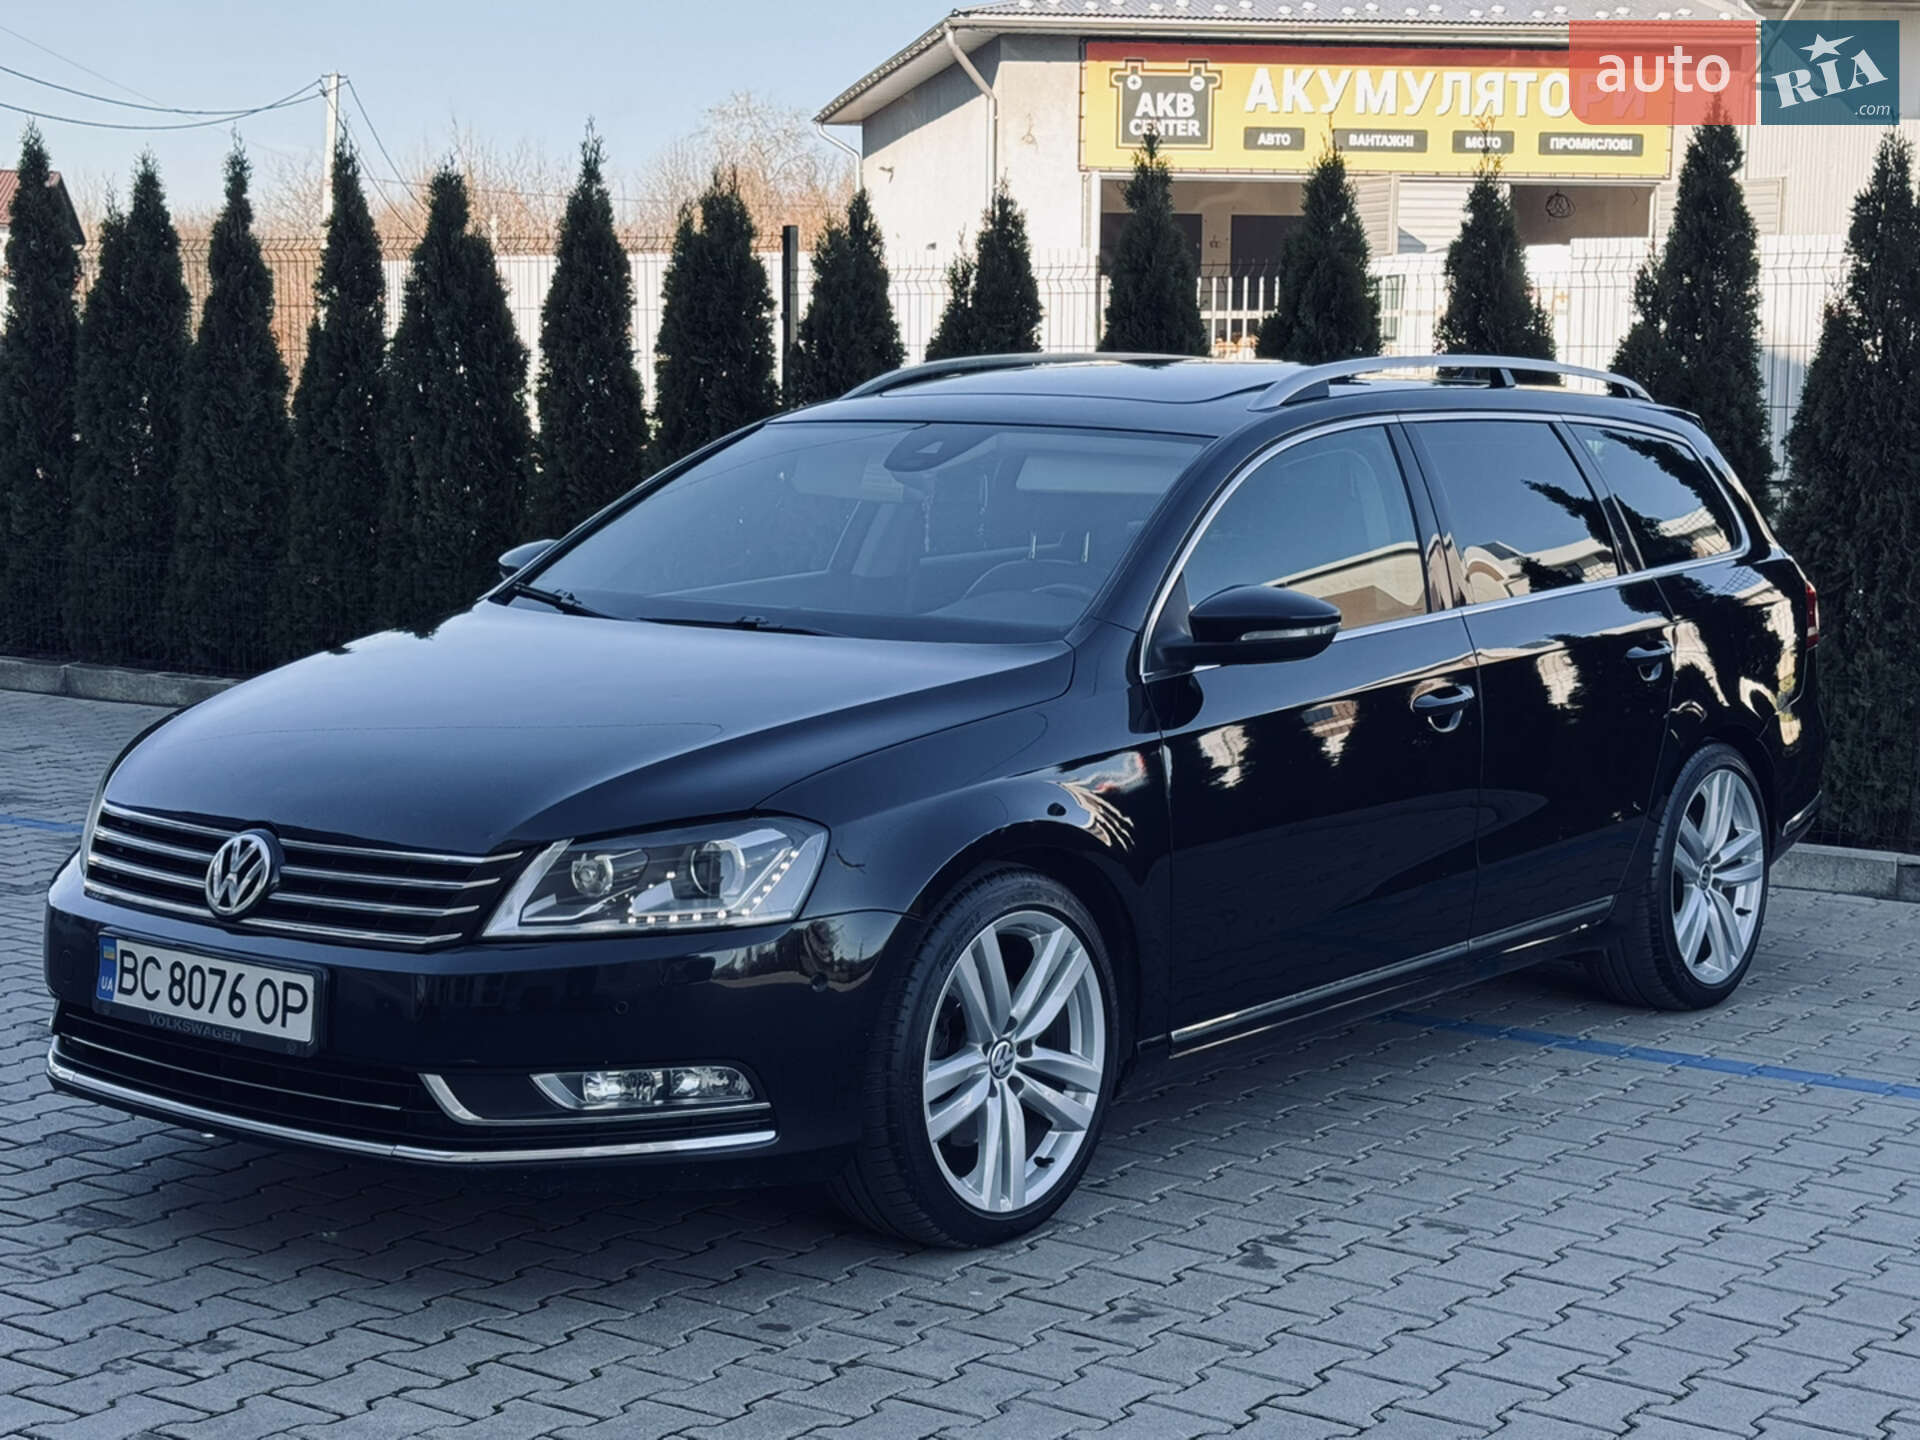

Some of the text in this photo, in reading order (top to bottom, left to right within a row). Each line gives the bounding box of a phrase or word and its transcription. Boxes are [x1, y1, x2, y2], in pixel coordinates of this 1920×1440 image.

[1128, 119, 1201, 137] CENTER
[1257, 132, 1292, 146] АВТО
[1348, 134, 1415, 148] ВАНТАЖНІ
[1465, 136, 1502, 149] МОТО
[1550, 137, 1633, 151] ПРОМИСЛОВІ
[101, 976, 113, 991] UA
[117, 949, 309, 1028] BC 8076 OP
[149, 1013, 241, 1043] VOLKSWAGEN
